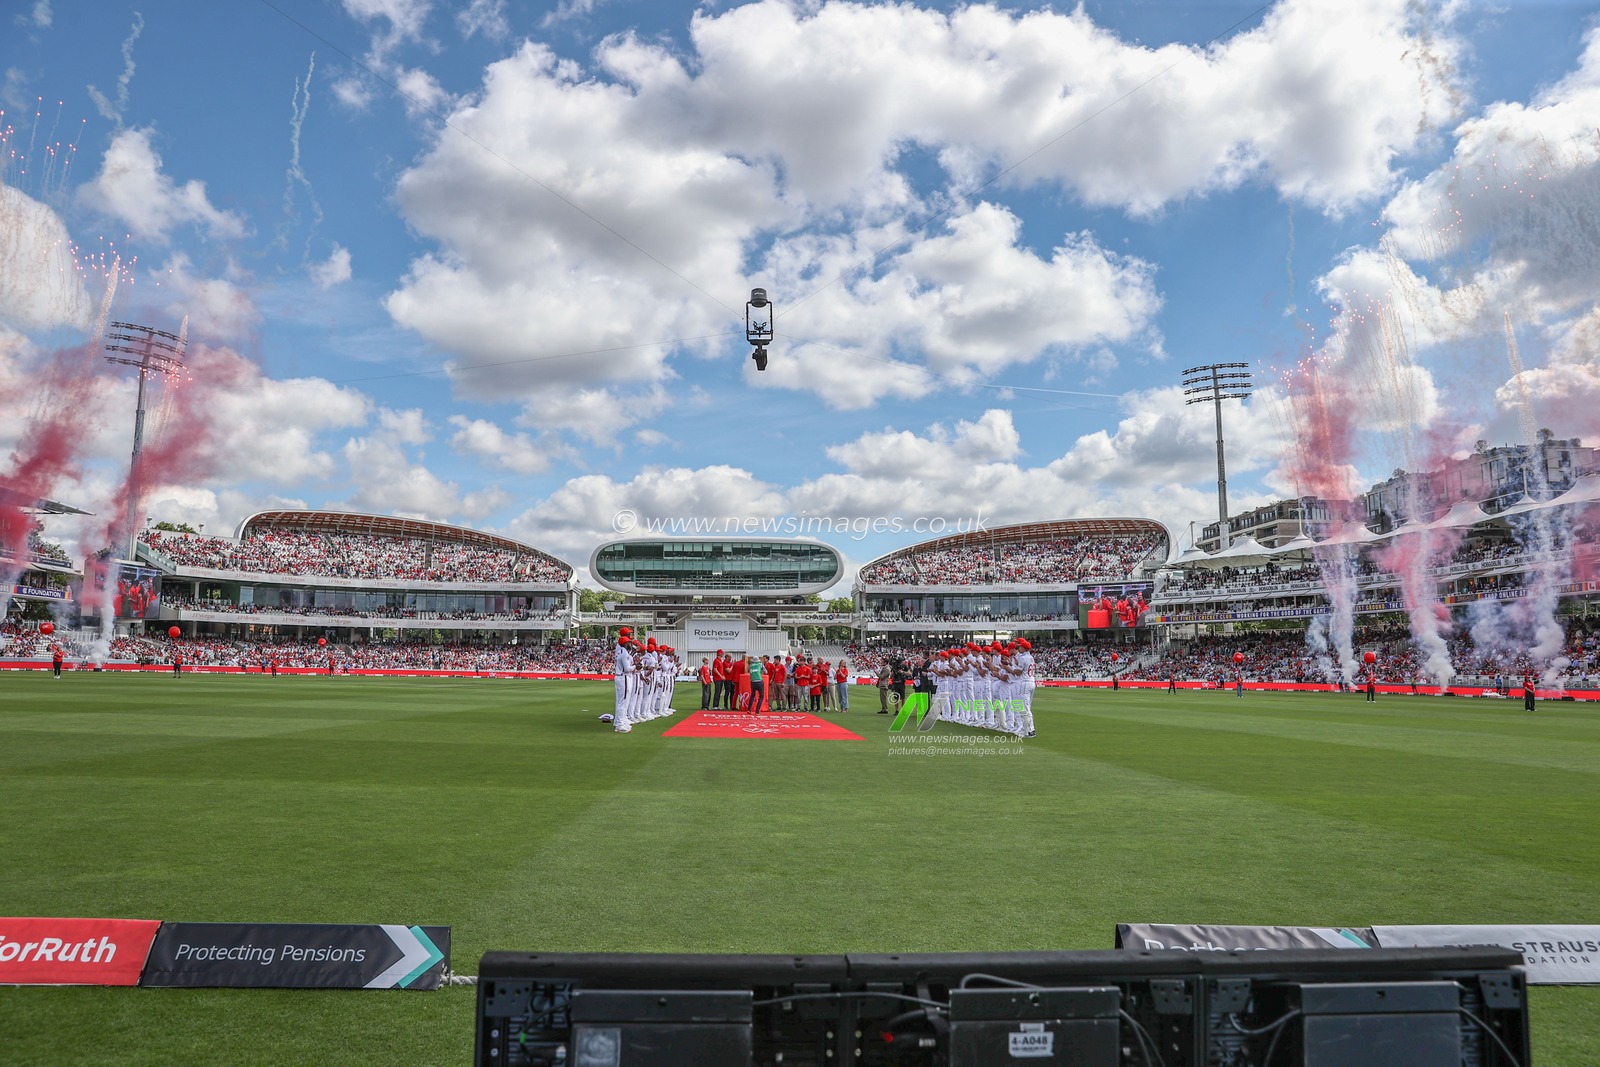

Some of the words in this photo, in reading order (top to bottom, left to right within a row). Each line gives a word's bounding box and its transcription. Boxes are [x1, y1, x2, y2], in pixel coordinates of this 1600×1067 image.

[28, 588, 61, 598] FOUNDATION
[1484, 592, 1498, 600] SHOP
[1499, 591, 1518, 599] ONLINE
[1236, 611, 1259, 619] WORKING
[694, 629, 740, 638] Rothesay
[1511, 940, 1600, 953] STRAUS
[175, 944, 275, 965] Protecting
[280, 945, 366, 962] Pensions
[1526, 956, 1591, 964] DATION
[1012, 1036, 1048, 1045] 4-A048
